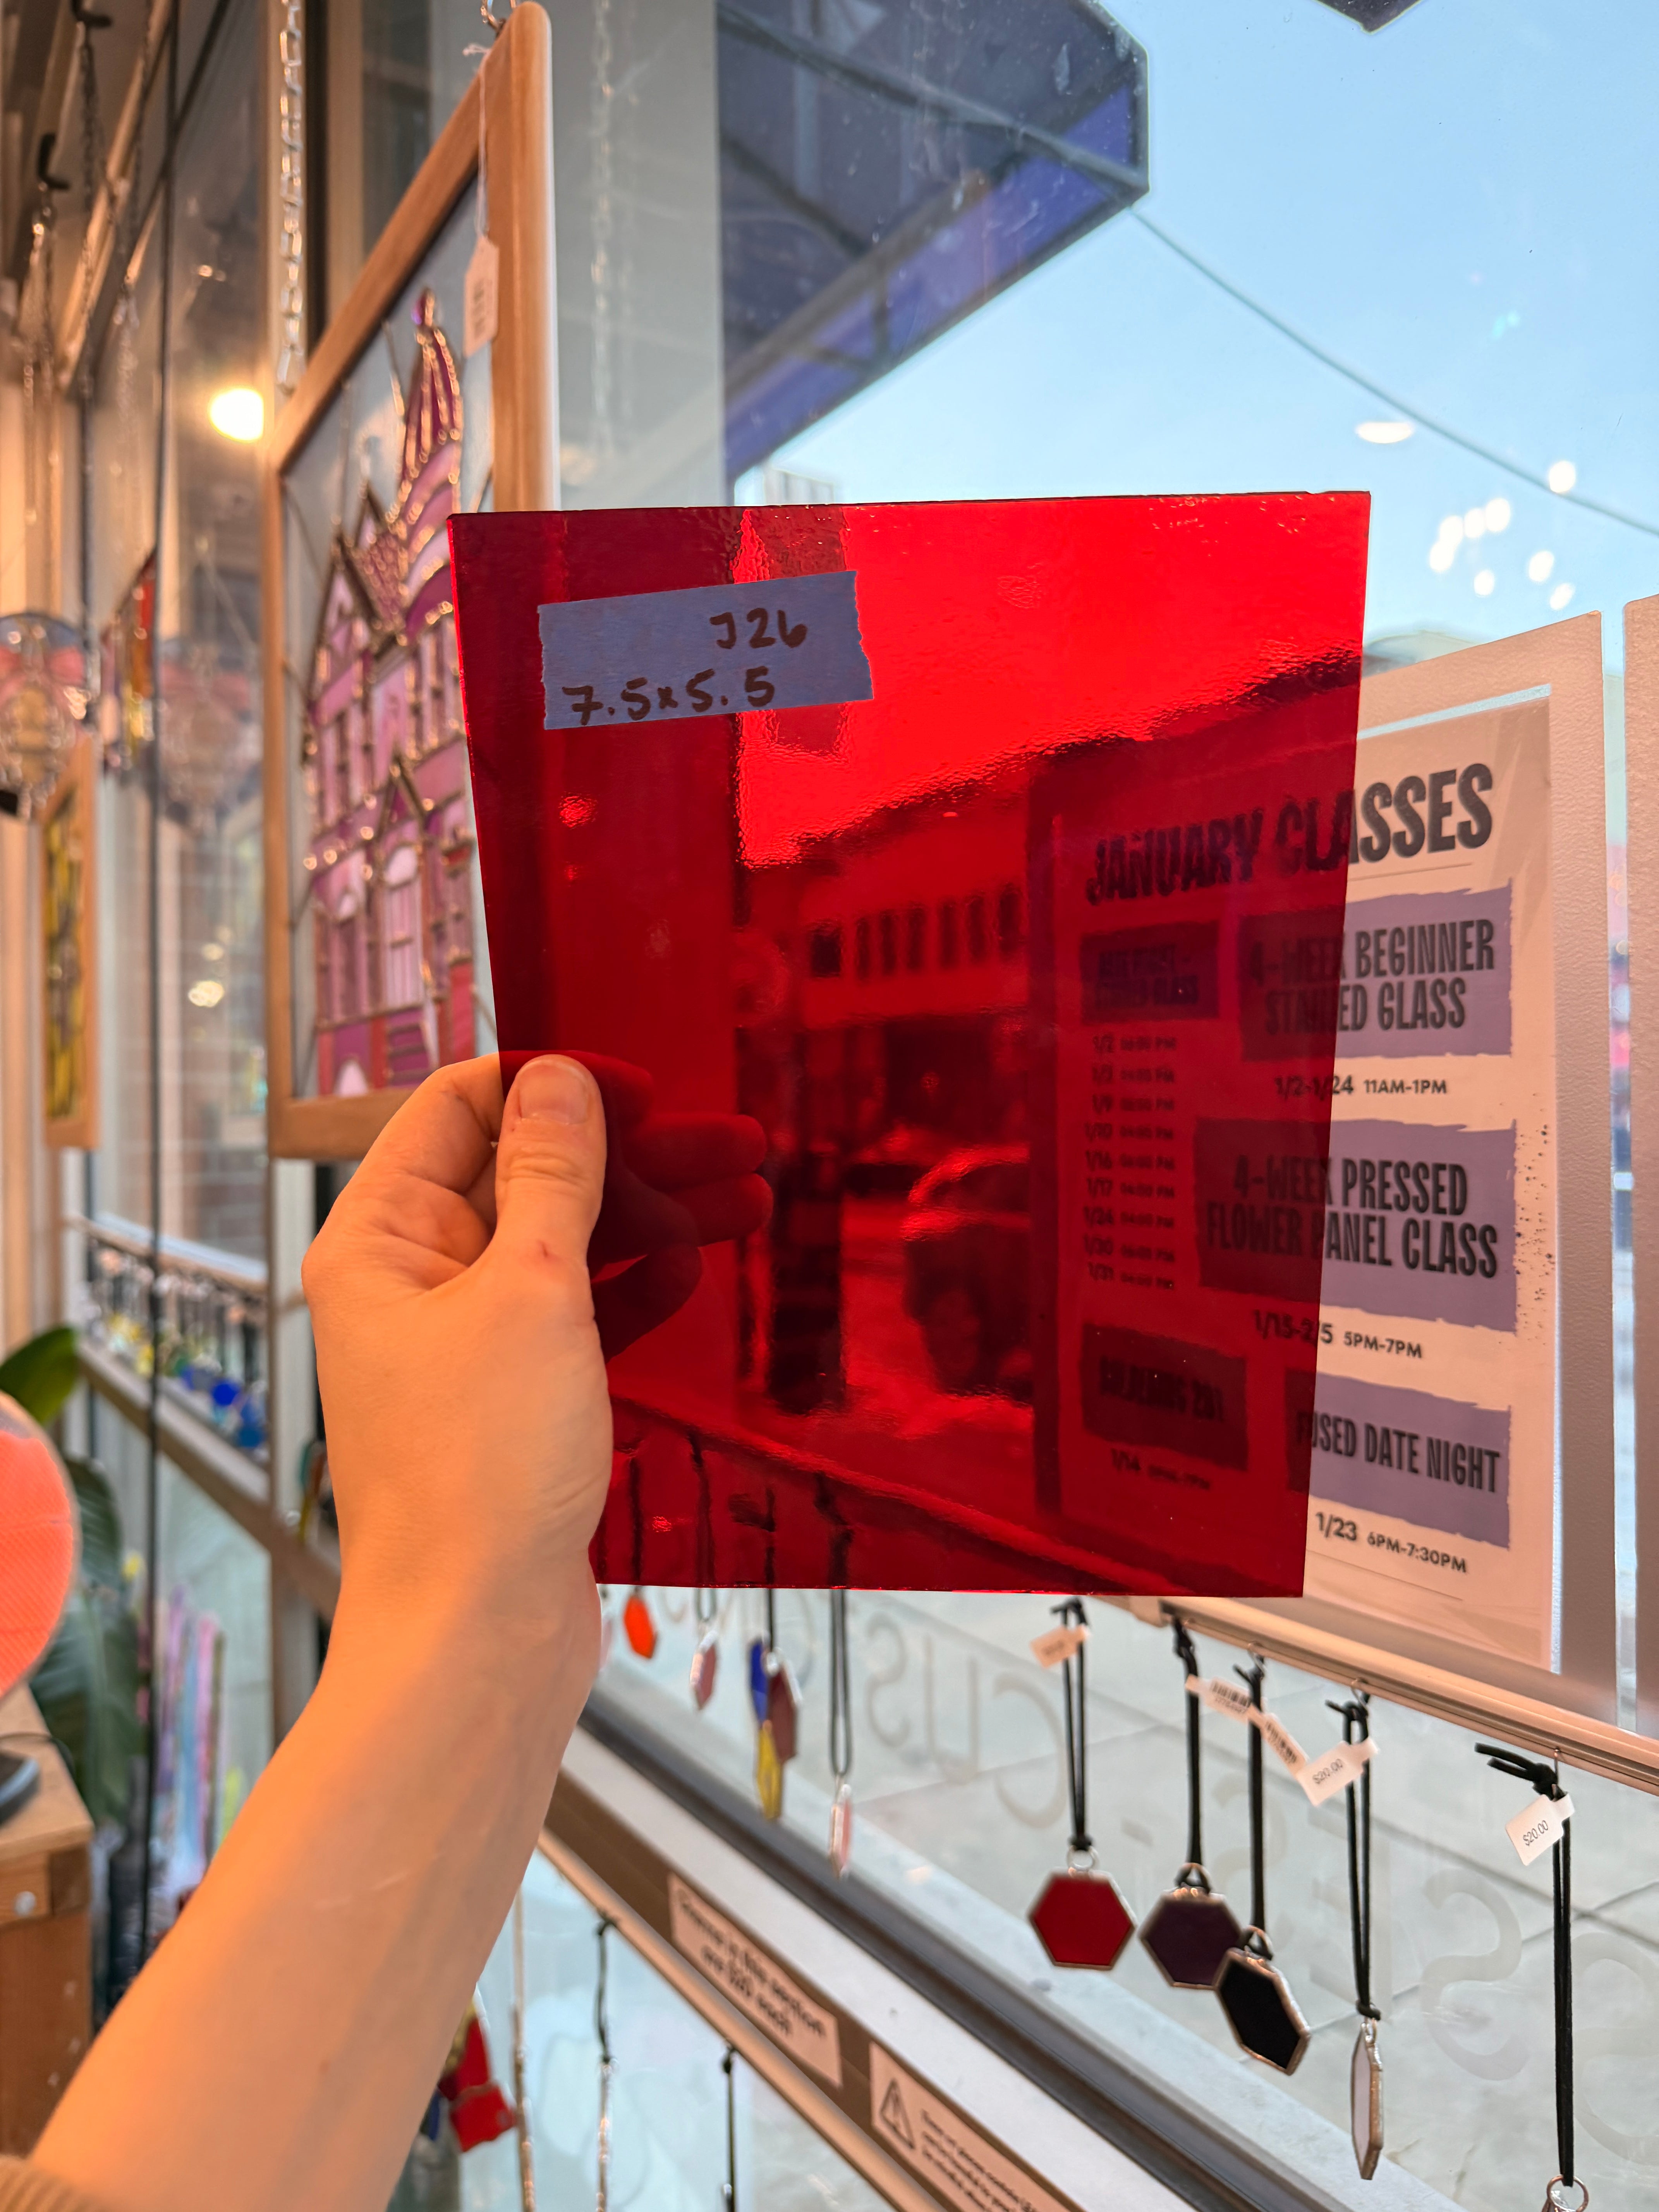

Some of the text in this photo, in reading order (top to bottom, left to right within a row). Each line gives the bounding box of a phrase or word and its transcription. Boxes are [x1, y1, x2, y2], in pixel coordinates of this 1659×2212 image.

[709, 607, 808, 650] J26
[1085, 763, 1493, 906] JANUARY CLASSES
[1355, 919, 1494, 978] BEGINNER
[1377, 977, 1466, 1031] GLASS
[1363, 1079, 1447, 1094] 11AM-1PM
[1233, 1154, 1468, 1217] 4-WEEK PRESSED
[1205, 1200, 1499, 1279] FLOWER PANEL CLASS
[1343, 1331, 1423, 1358] 5PM-7PM
[1296, 1411, 1500, 1493] FUSED DATE NIGHT
[1315, 1512, 1467, 1573] 1/23 6PM-7:30PM
[1312, 1759, 1344, 1784] $20.00
[1523, 1820, 1548, 1846] $20.00
